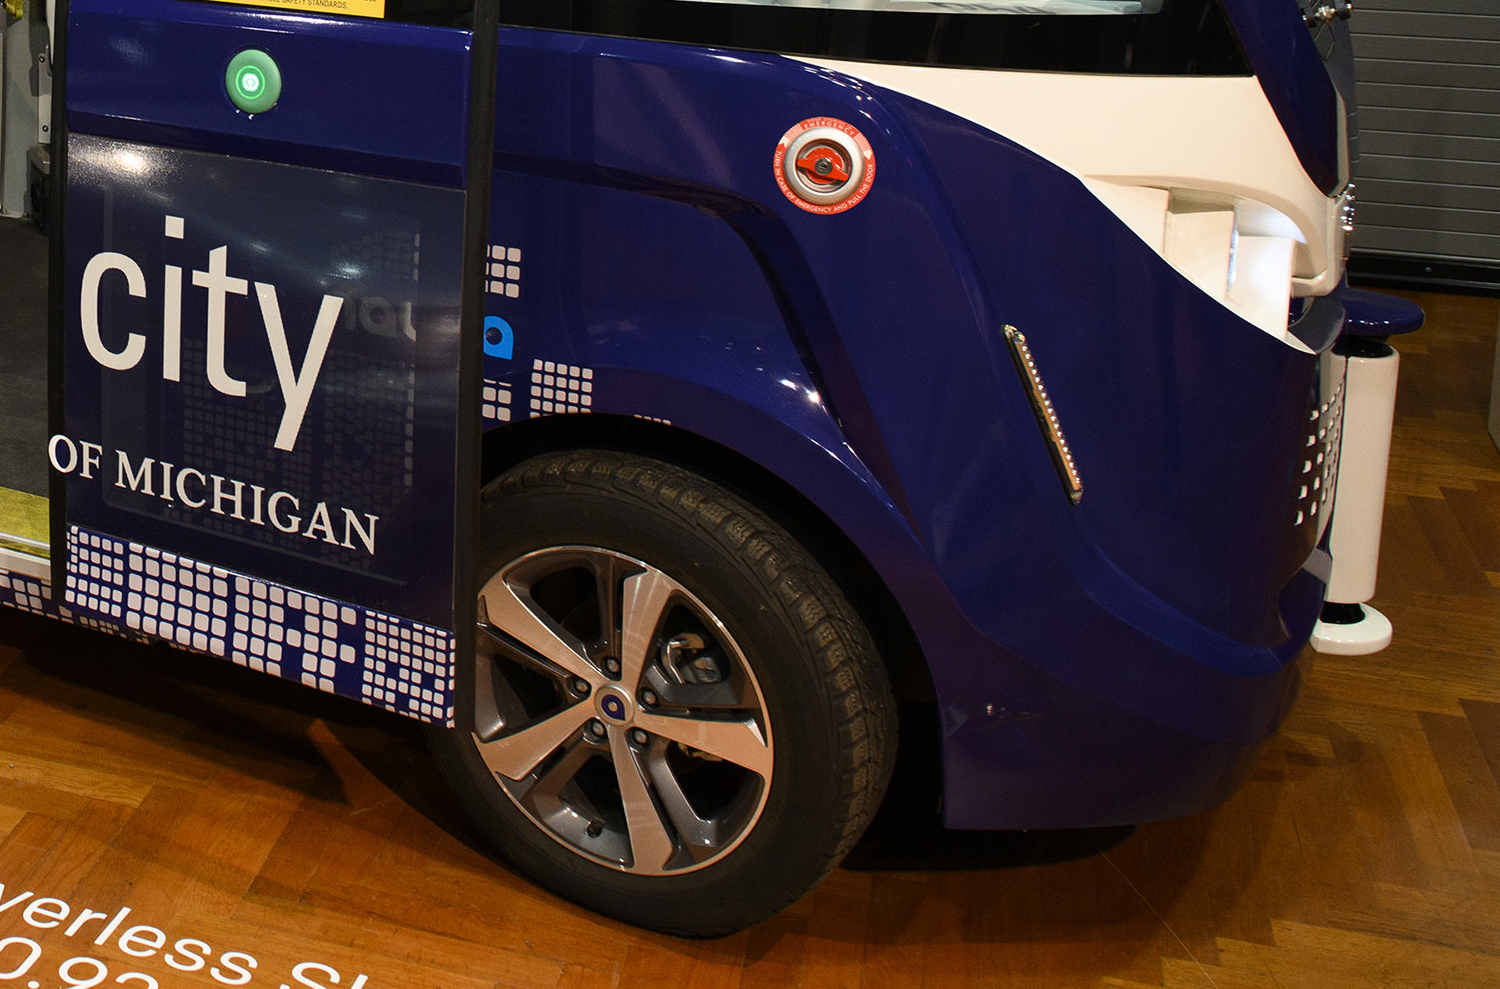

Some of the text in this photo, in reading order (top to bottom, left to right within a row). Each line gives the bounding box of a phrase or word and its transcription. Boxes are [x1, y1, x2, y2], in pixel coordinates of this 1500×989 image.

[804, 121, 855, 136] EMERGENCY
[777, 176, 787, 191] CASE
[786, 192, 796, 200] OF
[794, 198, 832, 213] EMERGENCY
[833, 203, 848, 212] AND
[848, 194, 862, 206] PULL
[860, 183, 869, 195] THE
[865, 163, 874, 182] DOOR
[80, 214, 344, 452] city
[48, 433, 103, 480] OF
[114, 449, 379, 556] MICHIGAN
